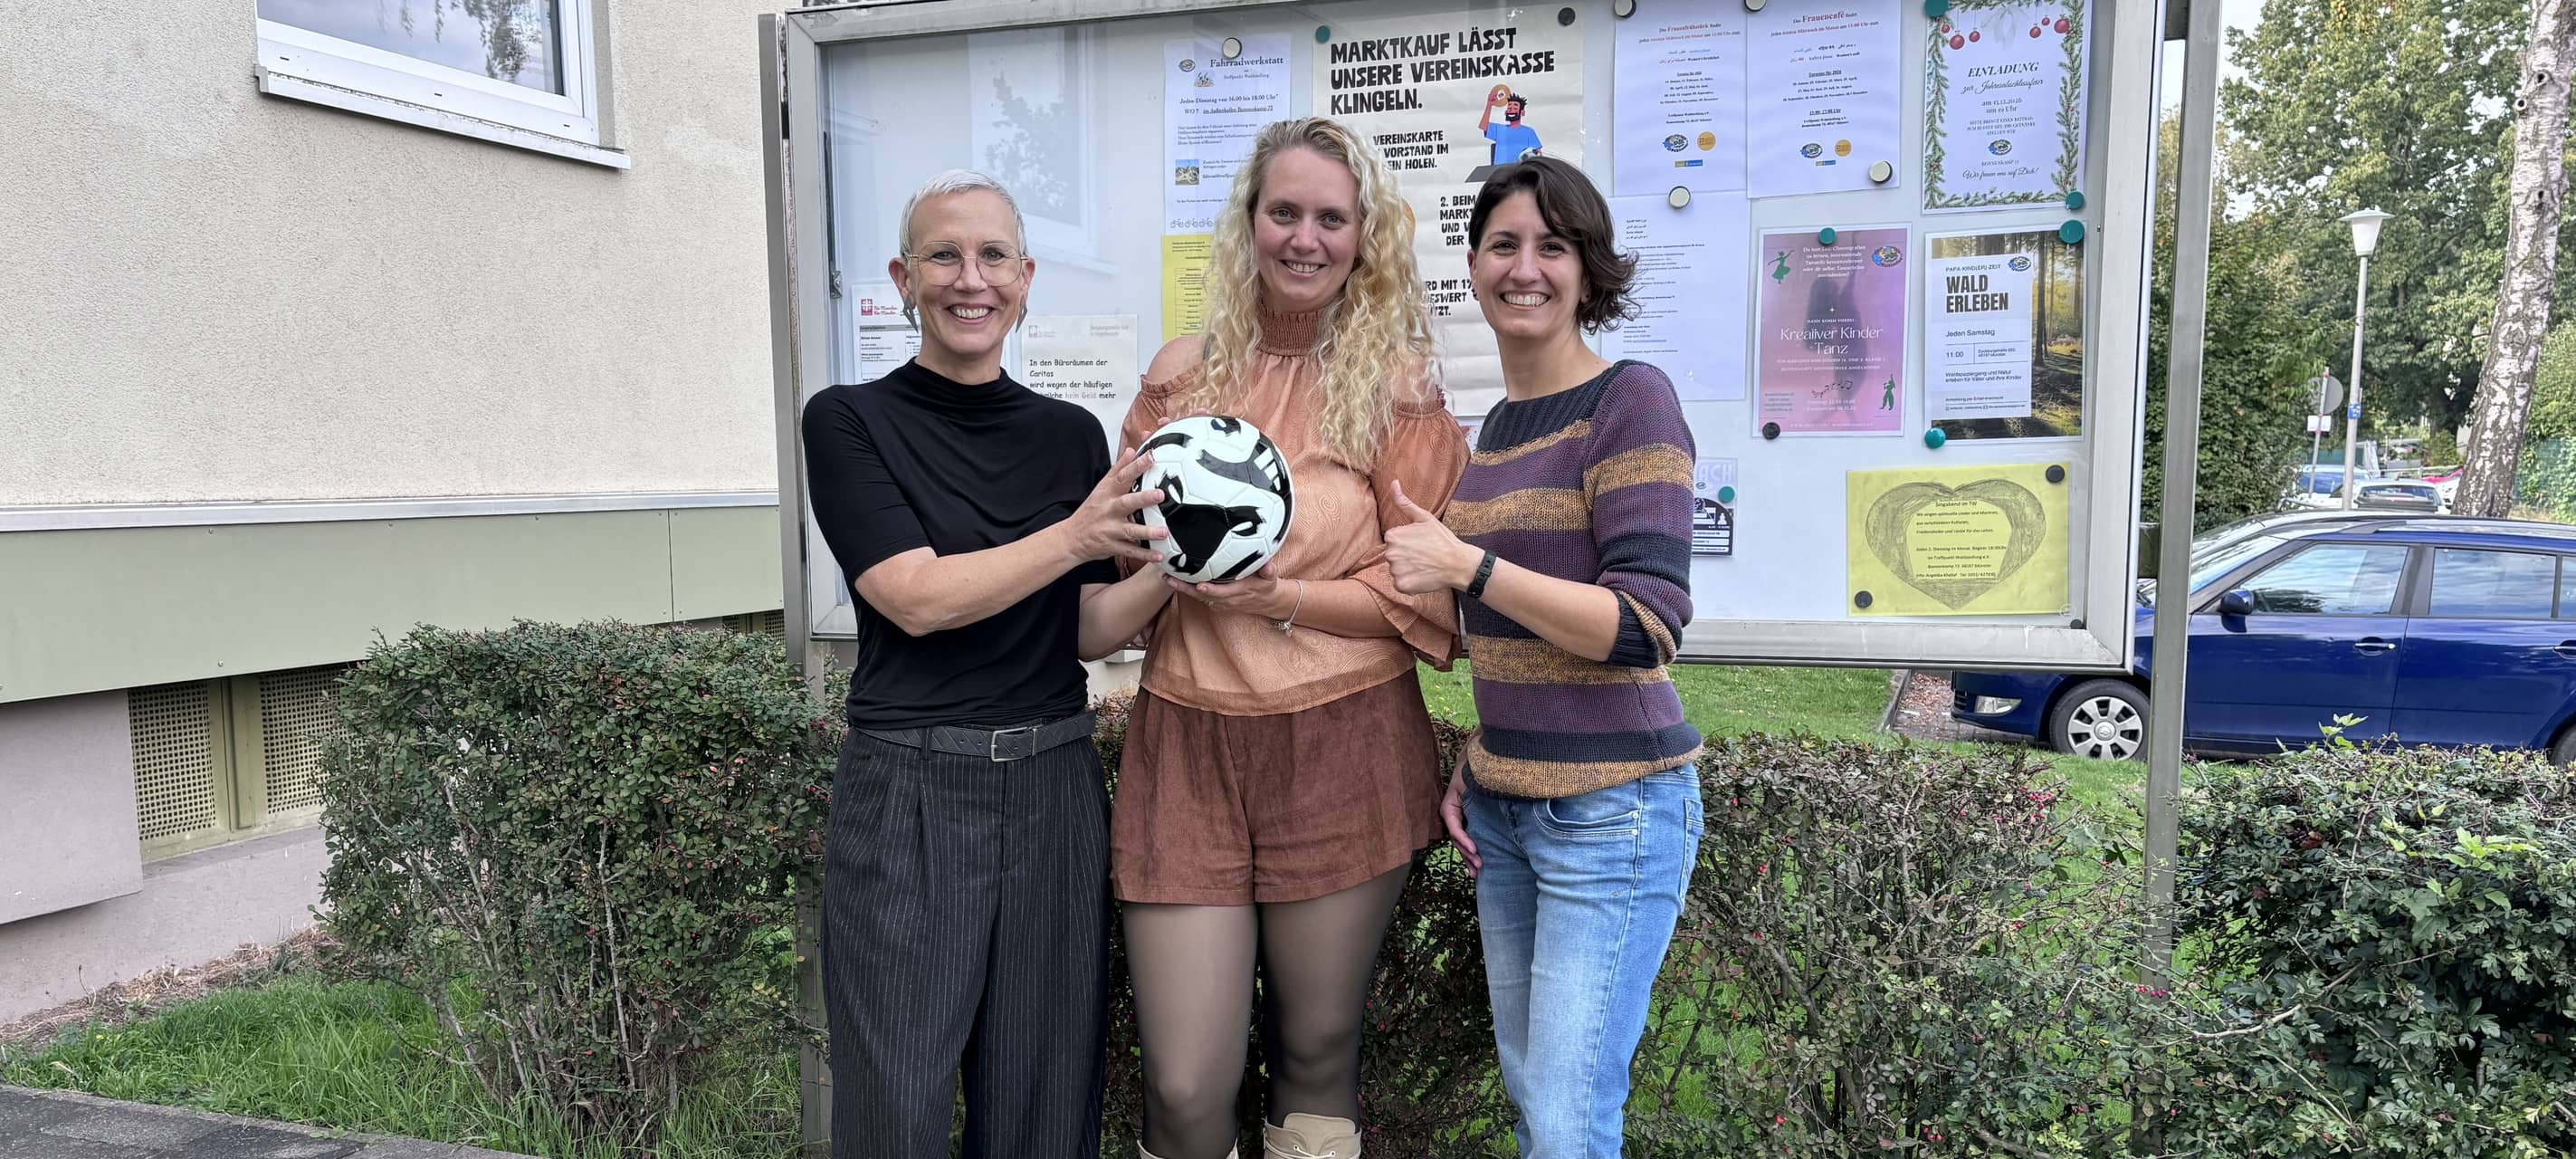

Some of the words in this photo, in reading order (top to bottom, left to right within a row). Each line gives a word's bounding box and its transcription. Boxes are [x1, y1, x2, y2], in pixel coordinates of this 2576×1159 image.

[1802, 11, 1845, 23] Frauencafé
[1331, 31, 1451, 64] MARKTKAUF
[1458, 26, 1517, 53] LÄSST
[1209, 55, 1284, 68] Fahrradwerkstatt
[1331, 63, 1403, 90] UNSERE
[1410, 50, 1556, 84] VEREINSKASSE
[1968, 61, 2040, 78] EINLADUNG
[1331, 88, 1423, 116] KLINGELN.
[1373, 130, 1444, 146] VEREINSKARTE
[1384, 144, 1434, 158] VORSTAND
[1436, 143, 1448, 155] IM
[1405, 158, 1437, 170] HOLEN.
[1440, 196, 1449, 207] 2.
[1453, 195, 1476, 206] BEIM
[1441, 222, 1460, 234] UND
[1446, 235, 1465, 246] DER
[1441, 279, 1458, 291] MIT
[1946, 274, 1988, 294] WALD
[1946, 292, 2008, 313] ERLEBEN
[1840, 326, 1884, 339] Kinder
[1966, 329, 1995, 337] Samstag
[1814, 342, 1849, 355] Tanz
[1054, 359, 1093, 367] Büroräumen
[1029, 369, 1054, 378] Caritas
[1069, 380, 1082, 388] der
[1083, 380, 1112, 389] häufigen
